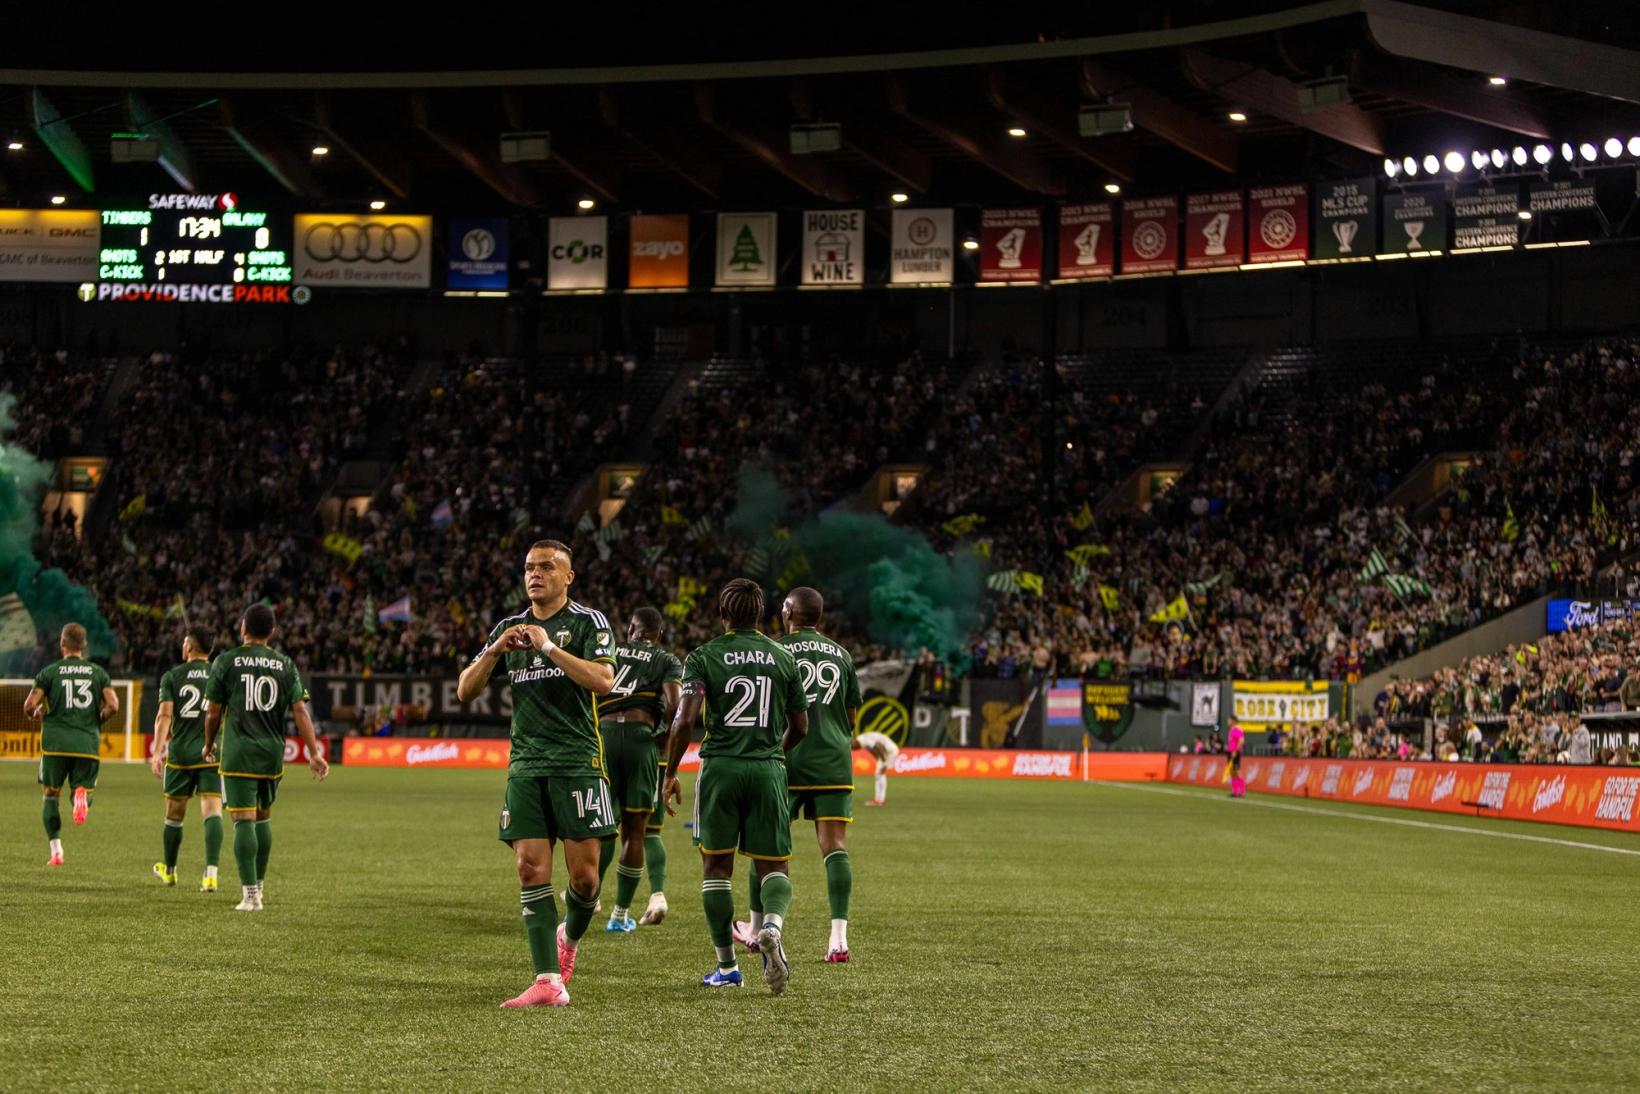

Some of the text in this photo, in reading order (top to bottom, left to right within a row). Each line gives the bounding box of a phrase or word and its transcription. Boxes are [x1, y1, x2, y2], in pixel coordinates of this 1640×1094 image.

[1211, 191, 1241, 202] NWSL
[1275, 185, 1306, 197] NWSL
[1333, 184, 1358, 197] 2015
[149, 194, 217, 209] SAFEWAY
[1187, 202, 1242, 214] CHAMPIONS
[1261, 197, 1296, 208] SHIELD
[1322, 195, 1368, 209] MLS CUP
[1456, 201, 1518, 217] CHAMPIONS
[1530, 196, 1595, 211] CHAMPIONS
[102, 211, 151, 225] TIMBERS
[1322, 207, 1368, 218] CHAMPIONS
[807, 213, 859, 232] HOUSE
[49, 228, 97, 237] GMC
[140, 226, 149, 247] 1
[1455, 232, 1519, 248] CHAMPIONS
[552, 239, 604, 264] COR
[632, 240, 685, 260] zayo
[893, 247, 951, 260] HAMPTON
[40, 252, 97, 265] Beaverton
[302, 268, 423, 281] Audi Beaverton
[811, 262, 854, 281] WINE
[902, 261, 943, 273] LUMBER
[1564, 601, 1599, 627] Ford
[615, 646, 653, 663] MILLER
[783, 640, 843, 659] MOSQUERA
[234, 656, 284, 672] EVANDER
[723, 650, 776, 666] CHARA
[187, 668, 209, 680] AYAL
[796, 658, 841, 705] 29
[61, 678, 94, 709] 13
[179, 683, 209, 719] 2
[240, 673, 279, 713] 10
[328, 681, 514, 717] TIMBERS
[723, 675, 773, 728] 21
[1235, 699, 1327, 717] ROSE CITY
[406, 741, 459, 764] Goldfish
[894, 751, 946, 774] Goldfish
[1532, 773, 1566, 814] Goldfish
[571, 788, 601, 819] 14
[1594, 794, 1636, 822] HANDFUL
